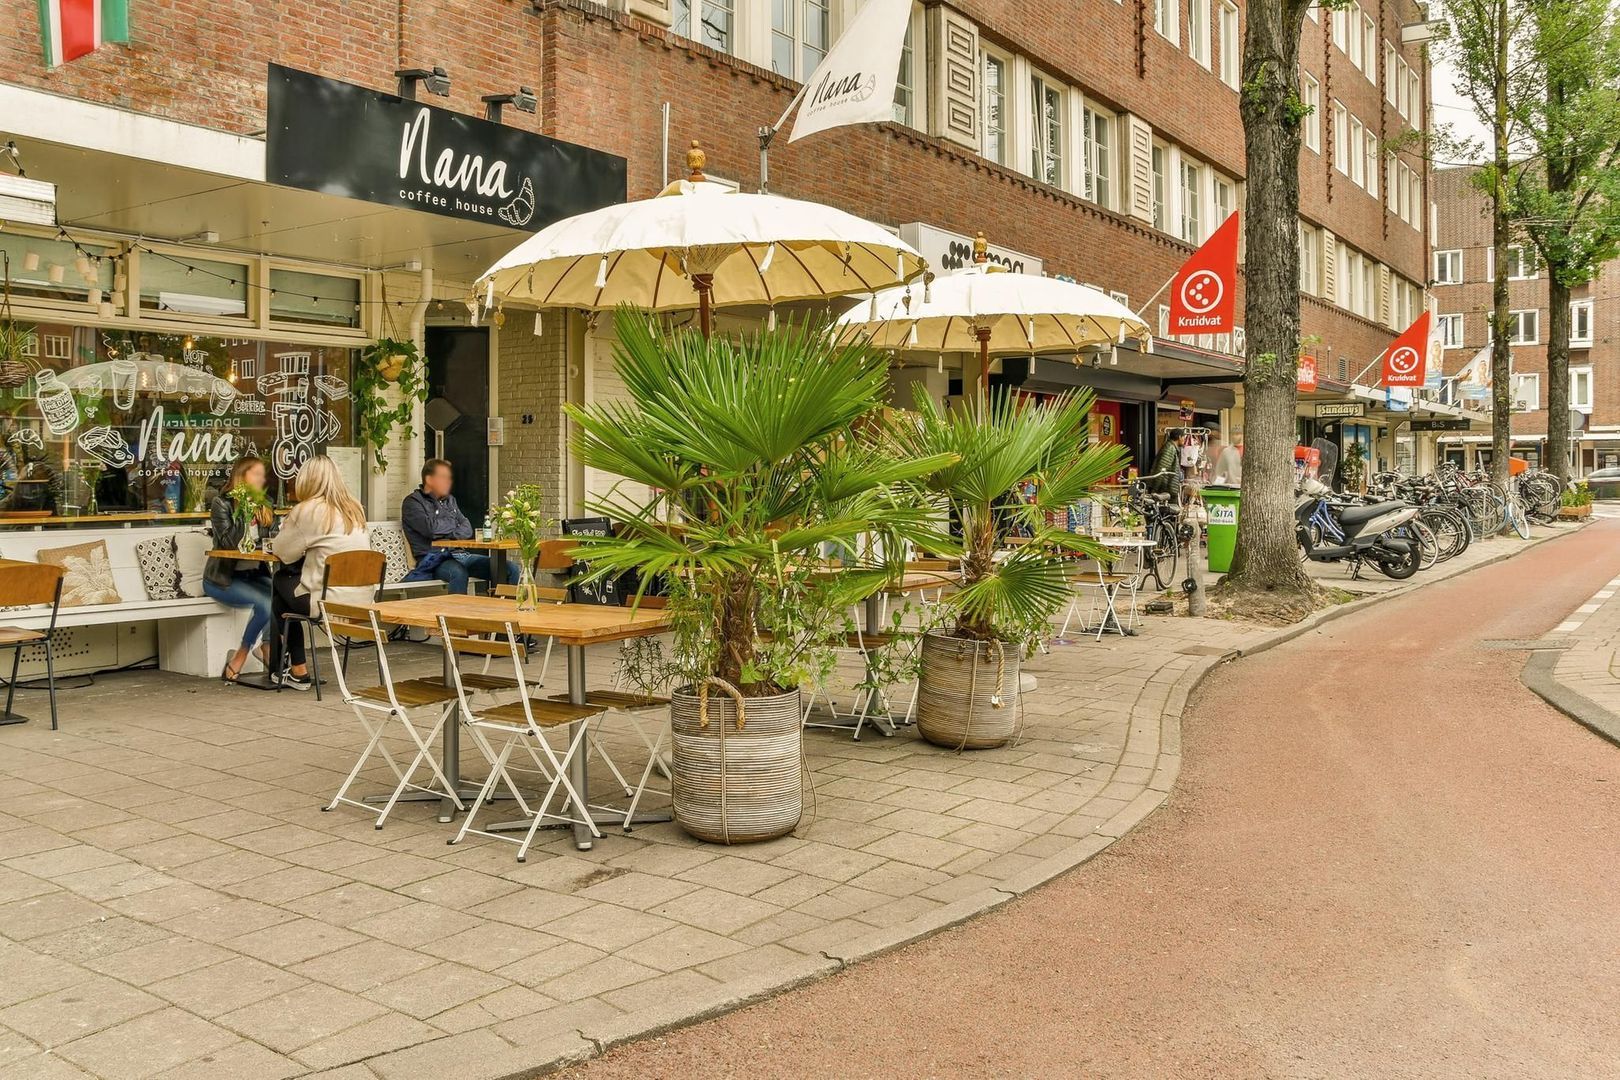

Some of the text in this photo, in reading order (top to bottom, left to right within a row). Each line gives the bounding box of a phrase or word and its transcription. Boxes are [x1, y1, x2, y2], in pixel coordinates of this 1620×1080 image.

[810, 70, 863, 108] Nana
[399, 107, 514, 198] Nana
[399, 189, 493, 216] coffee house
[1178, 315, 1222, 327] Kruidvat
[1388, 374, 1417, 382] Kruidvat
[272, 402, 315, 442] TO
[1321, 404, 1360, 415] Sundays
[138, 405, 239, 463] Nana
[138, 467, 221, 477] coffee house
[272, 441, 312, 480] GO
[1216, 510, 1233, 518] SITA
